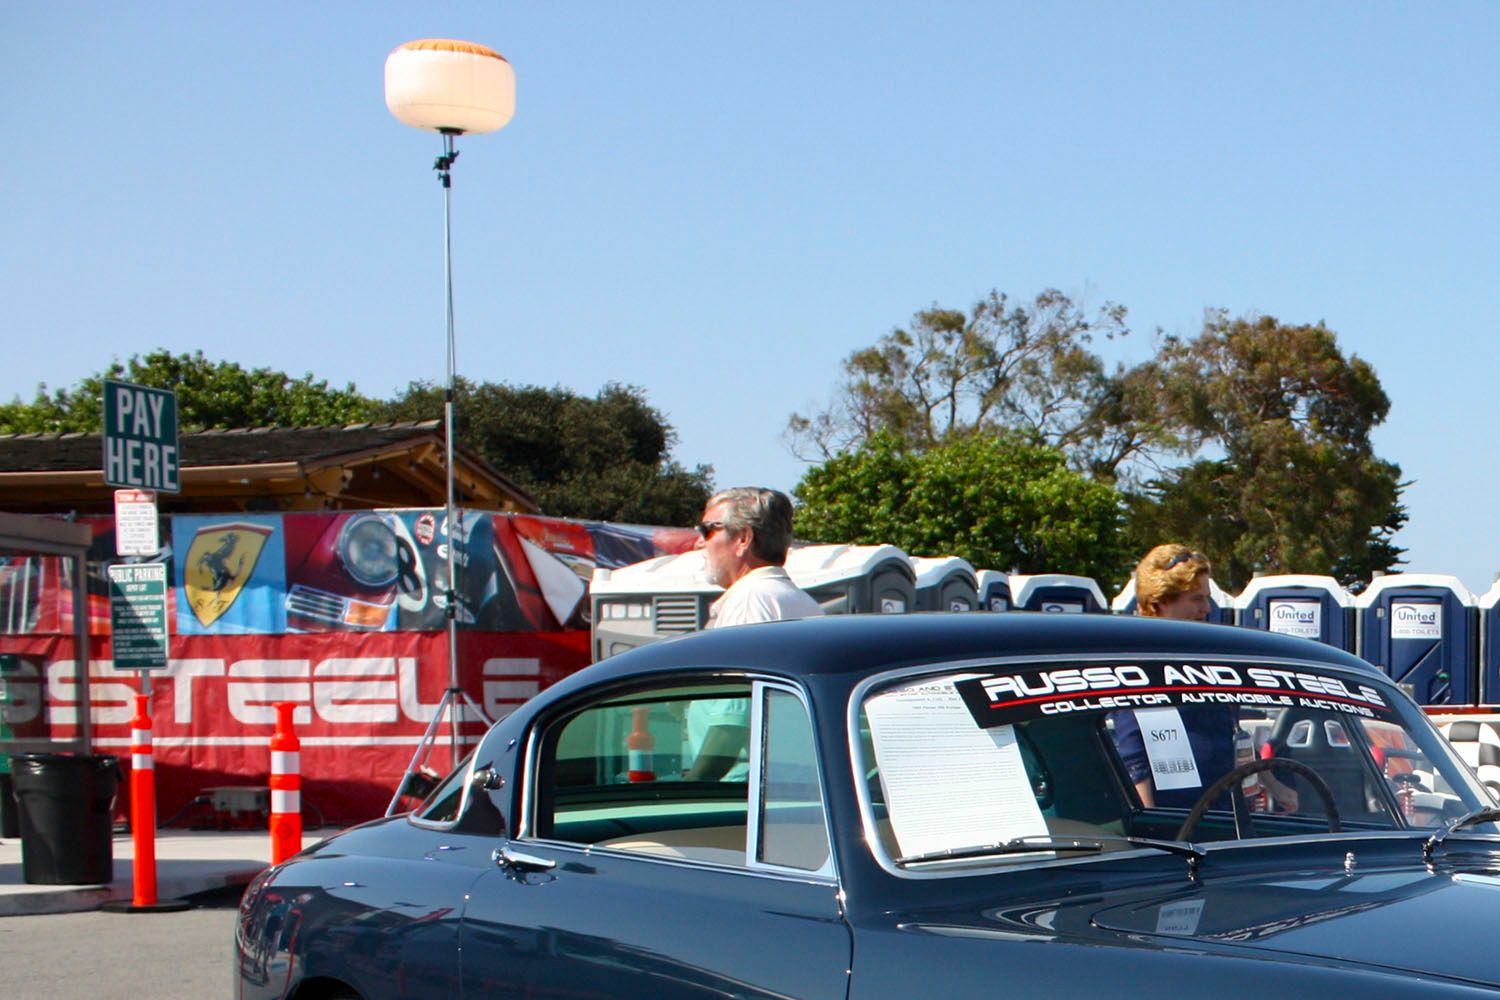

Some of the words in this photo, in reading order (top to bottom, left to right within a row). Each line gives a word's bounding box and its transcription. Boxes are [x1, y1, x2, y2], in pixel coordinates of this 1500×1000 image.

[116, 387, 164, 438] PAY
[106, 436, 177, 490] HERE
[134, 567, 164, 581] PARKING
[1277, 610, 1314, 620] United
[1398, 611, 1436, 621] United
[981, 666, 1150, 701] RUSSO
[1164, 665, 1242, 686] AND
[1247, 668, 1386, 707] STEELE
[1040, 693, 1171, 715] COLLECTOR
[1181, 692, 1295, 706] AUTOMOBILE
[1299, 697, 1375, 718] AUCTIONS
[1151, 728, 1178, 742] S677
